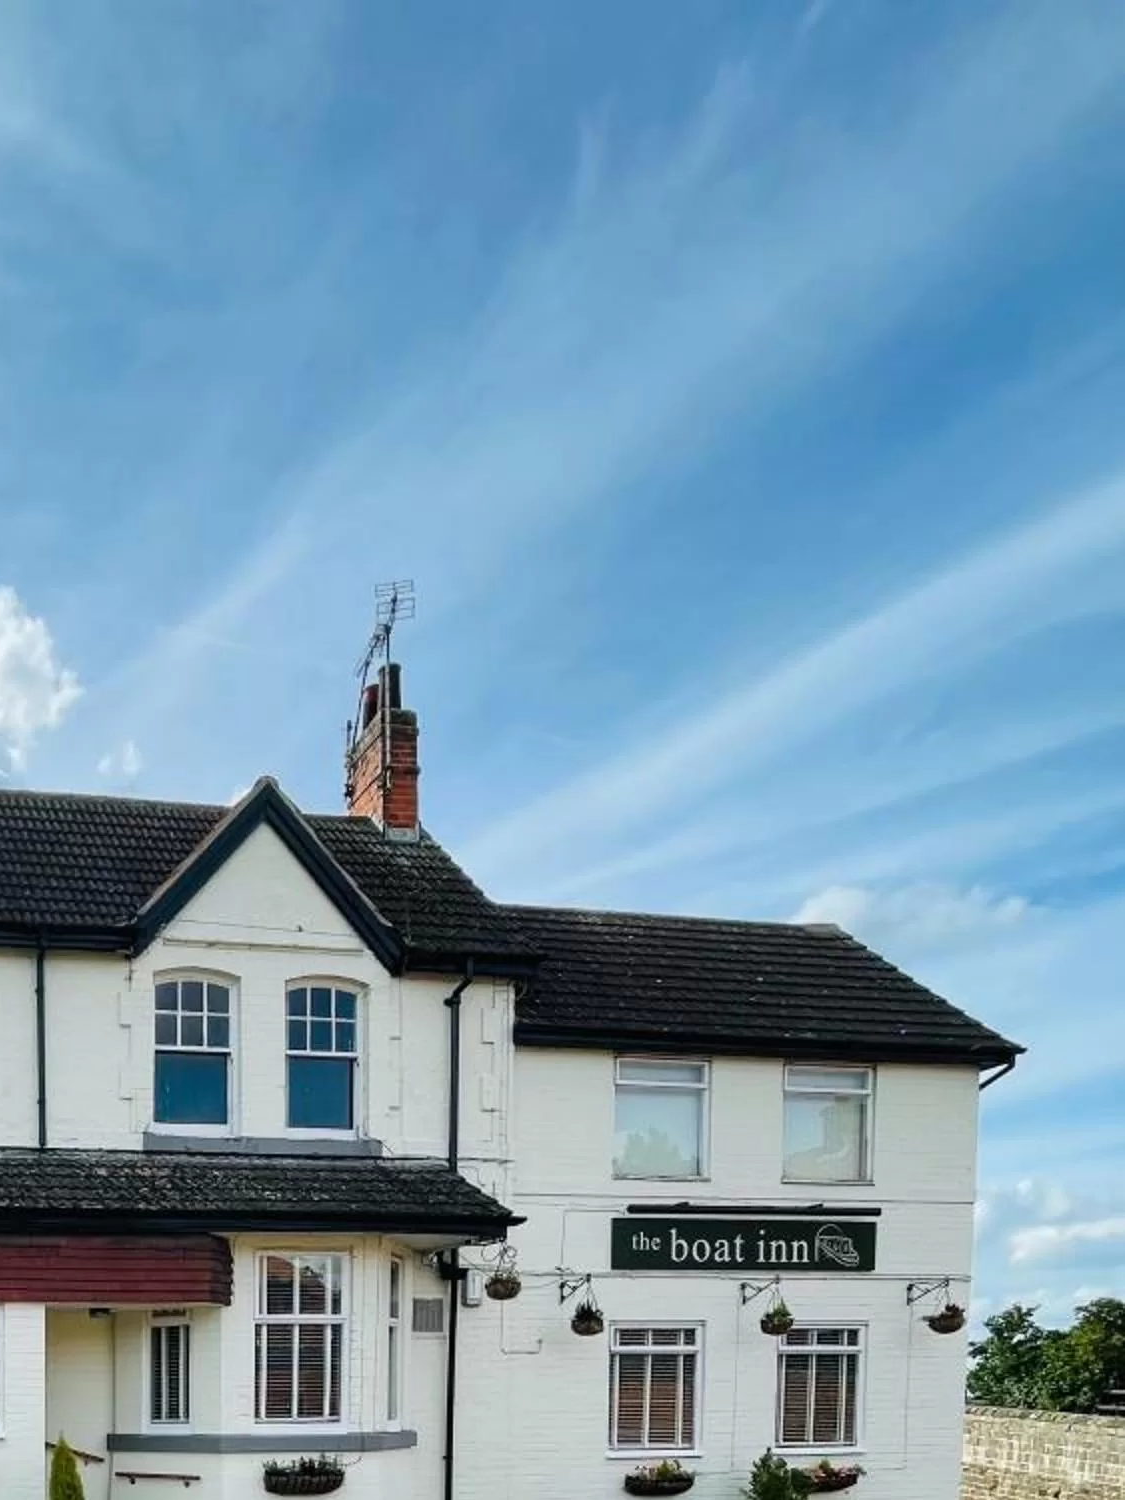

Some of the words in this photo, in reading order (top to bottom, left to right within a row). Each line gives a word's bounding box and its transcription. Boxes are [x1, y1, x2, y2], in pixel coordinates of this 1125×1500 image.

[632, 1231, 661, 1251] the
[670, 1227, 745, 1263] boat
[756, 1229, 810, 1263] inn
